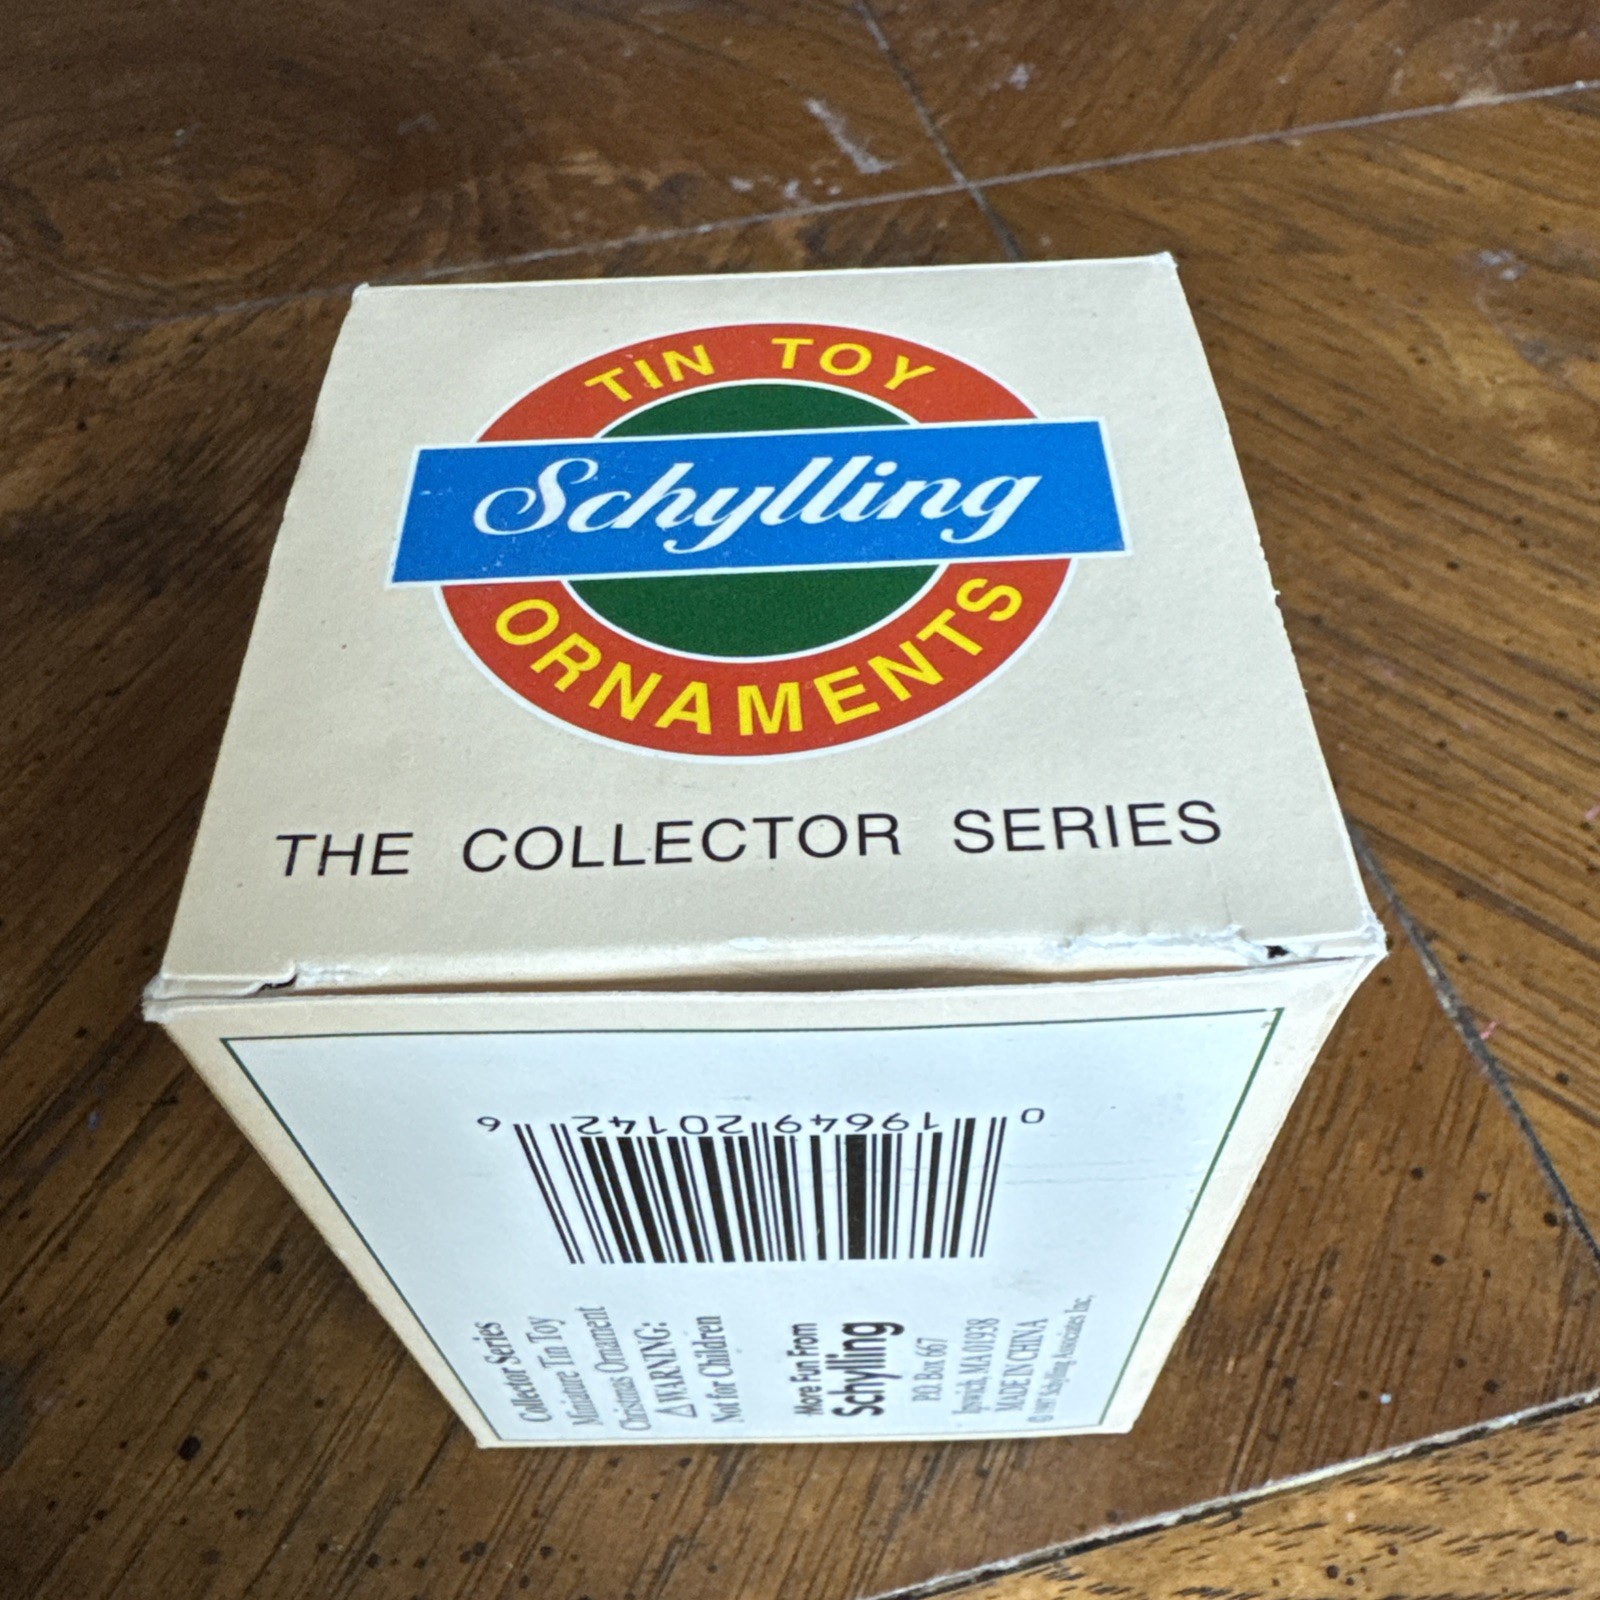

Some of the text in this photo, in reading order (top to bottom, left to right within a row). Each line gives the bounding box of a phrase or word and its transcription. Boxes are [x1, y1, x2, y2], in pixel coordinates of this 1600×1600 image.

[584, 337, 936, 402] TIN TOY
[472, 455, 1042, 555] Schylling
[495, 577, 1024, 737] ORNAMENTS
[276, 800, 1221, 878] THE COLLECTOR SERIES
[476, 1107, 1046, 1136] 0 19649 20142 6
[472, 1321, 552, 1423] Collector Series
[525, 1315, 603, 1426] Miniature Tin Toy
[574, 1305, 652, 1431] Christmas Ornament
[633, 1321, 688, 1403] WARNING:
[690, 1315, 745, 1423] Not for Children
[787, 1322, 823, 1417] More Fun From
[825, 1320, 905, 1417] Schylling
[913, 1359, 945, 1381] Box
[915, 1337, 949, 1357] 667
[958, 1353, 993, 1375] MA
[961, 1317, 1000, 1353] 01938
[995, 1318, 1049, 1412] MADE IN CHINA
